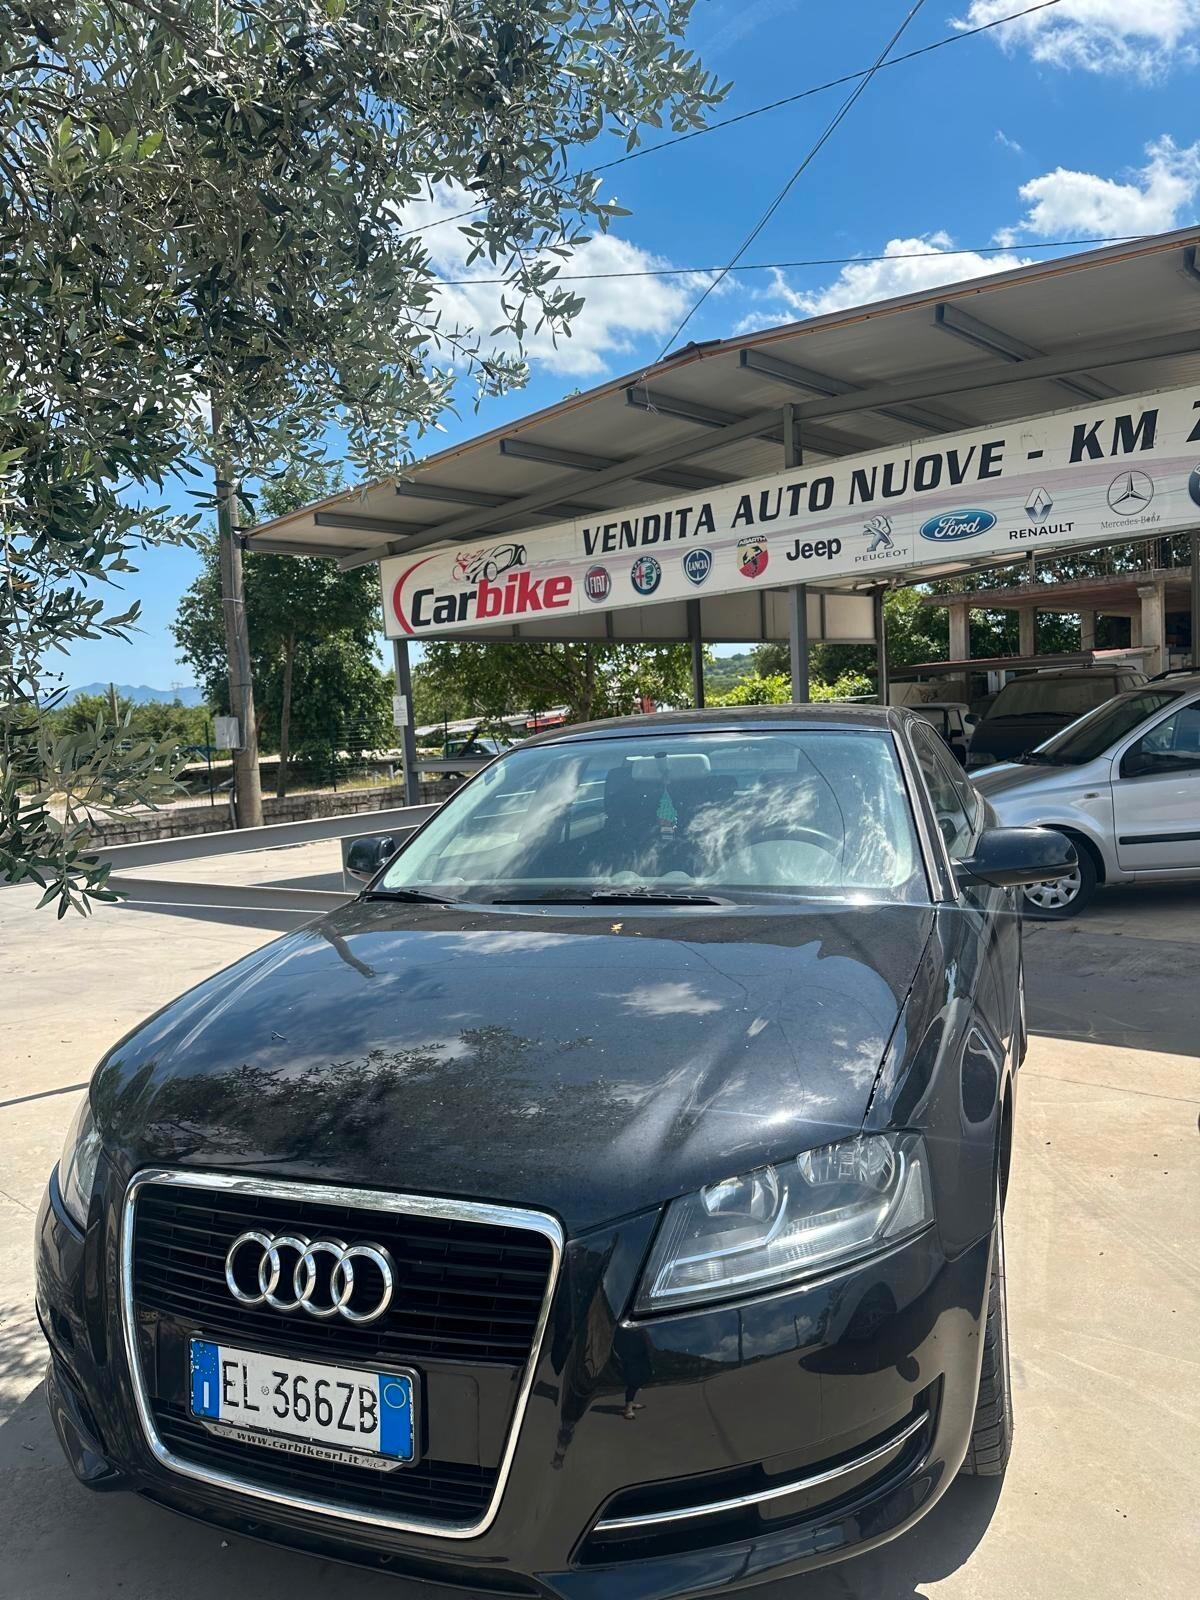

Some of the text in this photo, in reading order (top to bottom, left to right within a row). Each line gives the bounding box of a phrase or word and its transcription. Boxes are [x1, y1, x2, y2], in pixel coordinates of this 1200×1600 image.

[582, 503, 716, 556] VENDITA
[730, 476, 835, 529] AUTO
[848, 439, 1006, 506] NUOVE
[1068, 409, 1160, 464] KM
[934, 514, 981, 538] Ford
[1009, 521, 1075, 541] RENAULT
[1100, 513, 1161, 530] Mercedes-Benz
[738, 535, 768, 546] ABARTH
[786, 537, 842, 562] Jeep
[688, 560, 708, 572] LANCIA
[854, 548, 908, 563] PEUGEOT
[589, 574, 606, 594] FIAT
[410, 570, 573, 627] Carbike
[222, 1360, 379, 1434] EL 366ZB
[236, 1432, 360, 1465] www.carbikesrl.it
